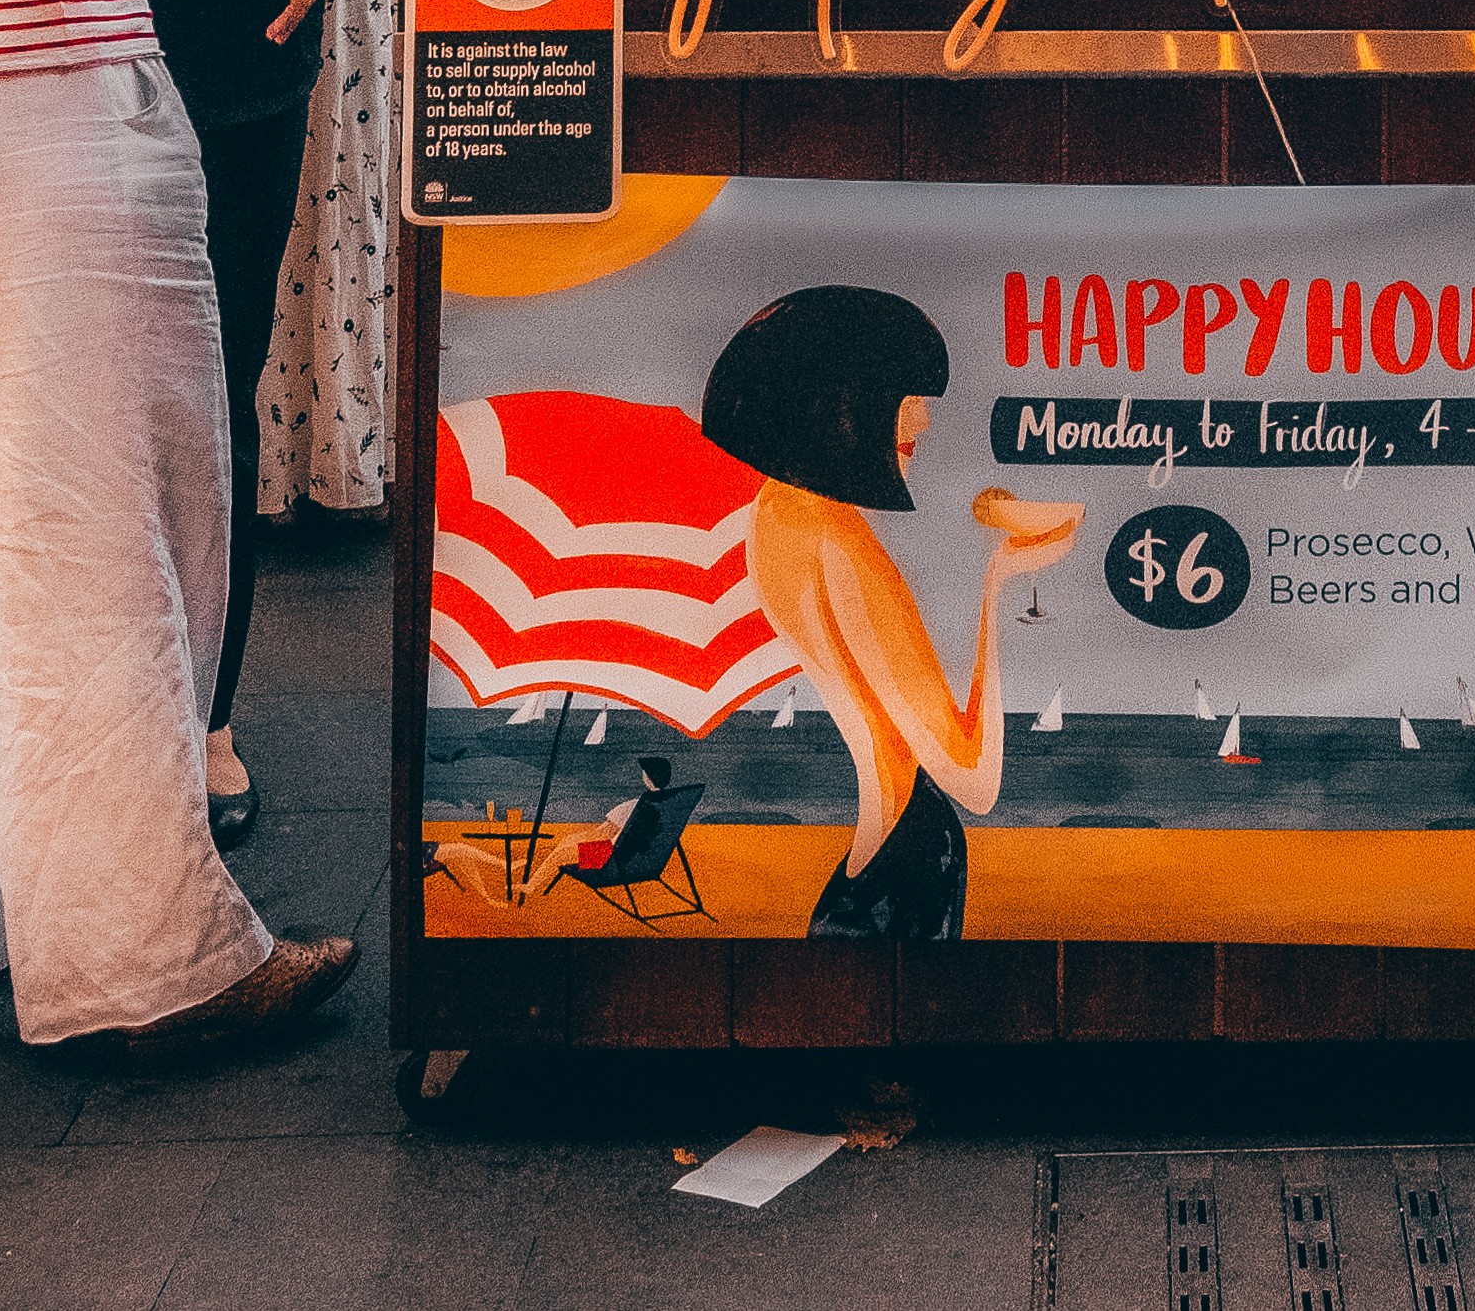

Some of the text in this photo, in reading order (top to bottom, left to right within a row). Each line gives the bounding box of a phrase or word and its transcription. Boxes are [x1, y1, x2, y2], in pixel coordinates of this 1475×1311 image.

[428, 42, 568, 61] It is against the law
[426, 60, 596, 80] to sell or supply alcohol
[426, 81, 586, 100] to, or to obtain alcohol
[426, 101, 515, 119] on behalf of,
[426, 120, 592, 140] a person under the age
[426, 141, 507, 159] of 18 years.
[1004, 271, 1290, 377] HAPPY
[1016, 395, 1188, 489] Monday
[1200, 396, 1233, 450] to
[1258, 397, 1395, 490] Friday,
[1419, 399, 1450, 450] 4
[1267, 526, 1451, 562] Prosecco,
[1127, 528, 1226, 605] $6
[1269, 575, 1377, 606] Beers
[1391, 573, 1462, 606] and
